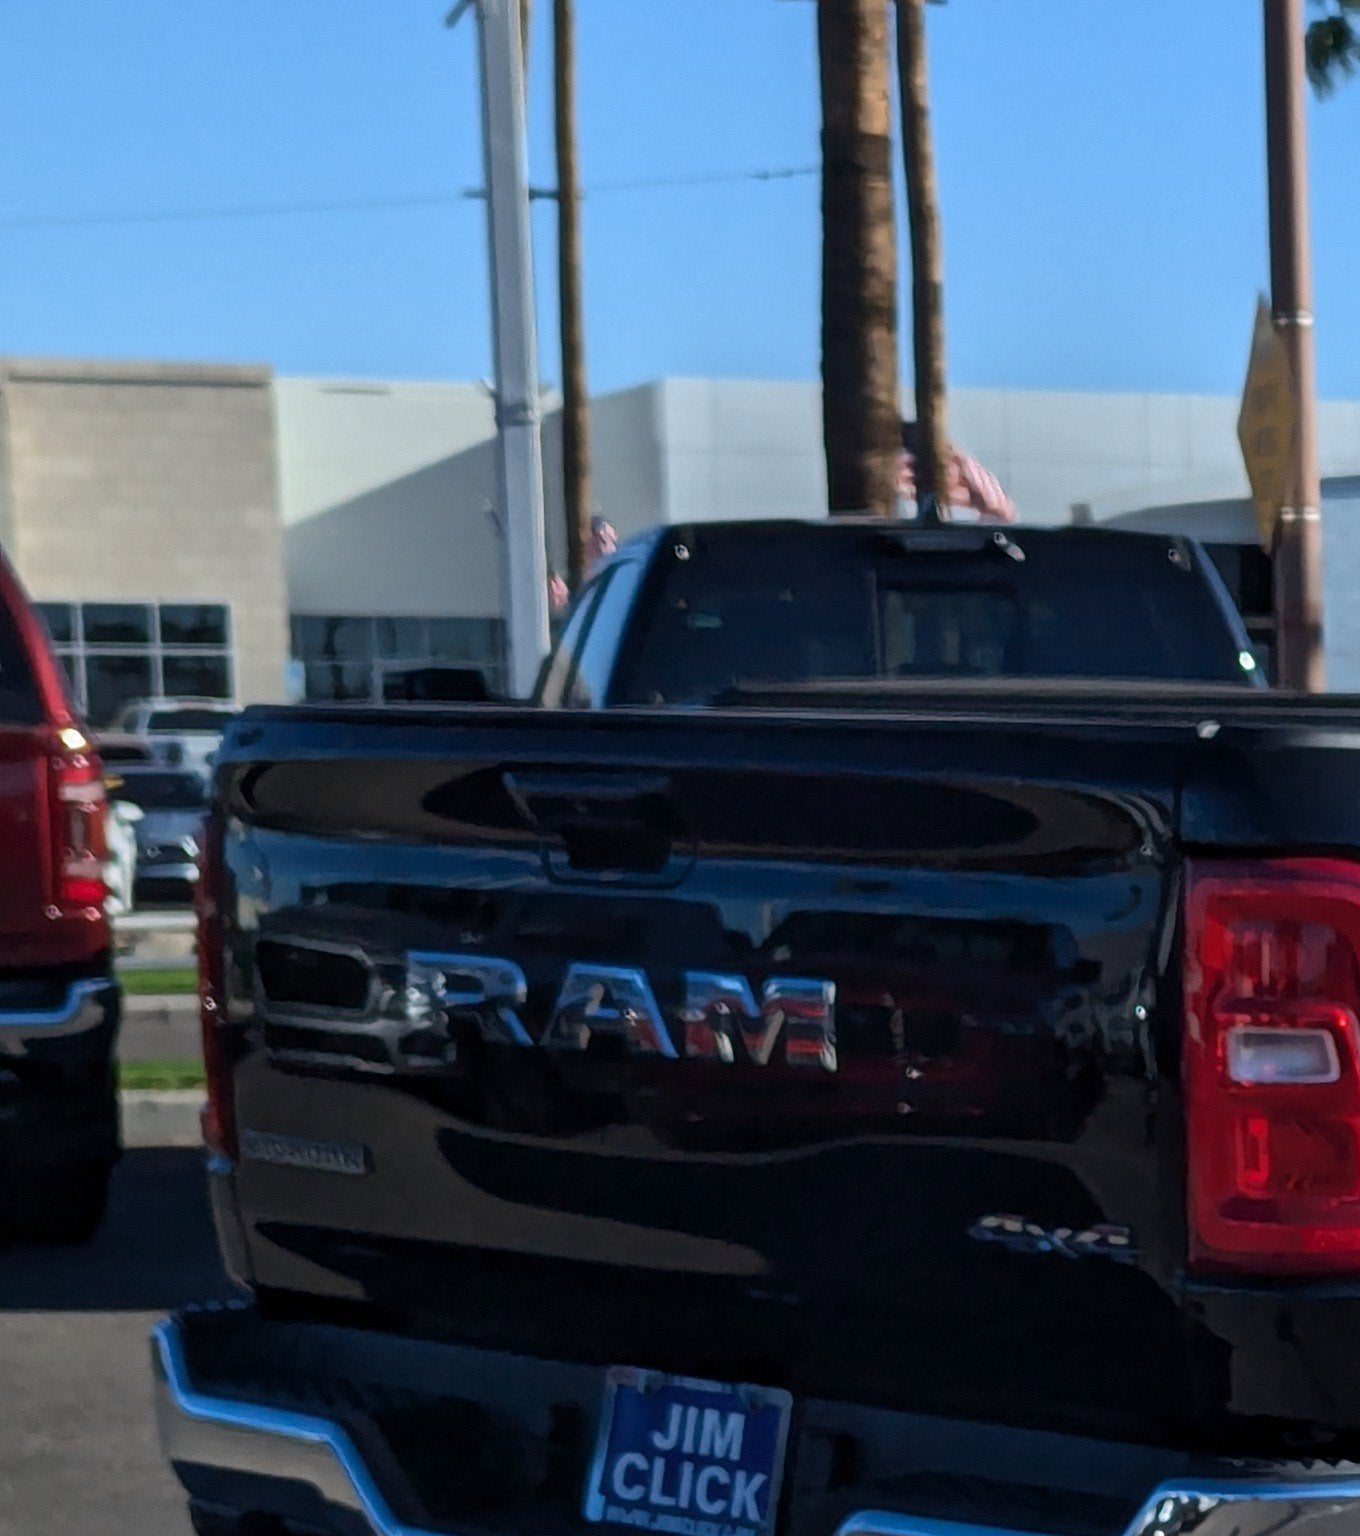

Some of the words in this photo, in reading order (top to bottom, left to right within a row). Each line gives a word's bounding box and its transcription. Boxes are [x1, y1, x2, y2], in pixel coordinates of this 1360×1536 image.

[405, 950, 838, 1073] RAM
[652, 1403, 746, 1461] JIM
[612, 1452, 769, 1523] CLICK
